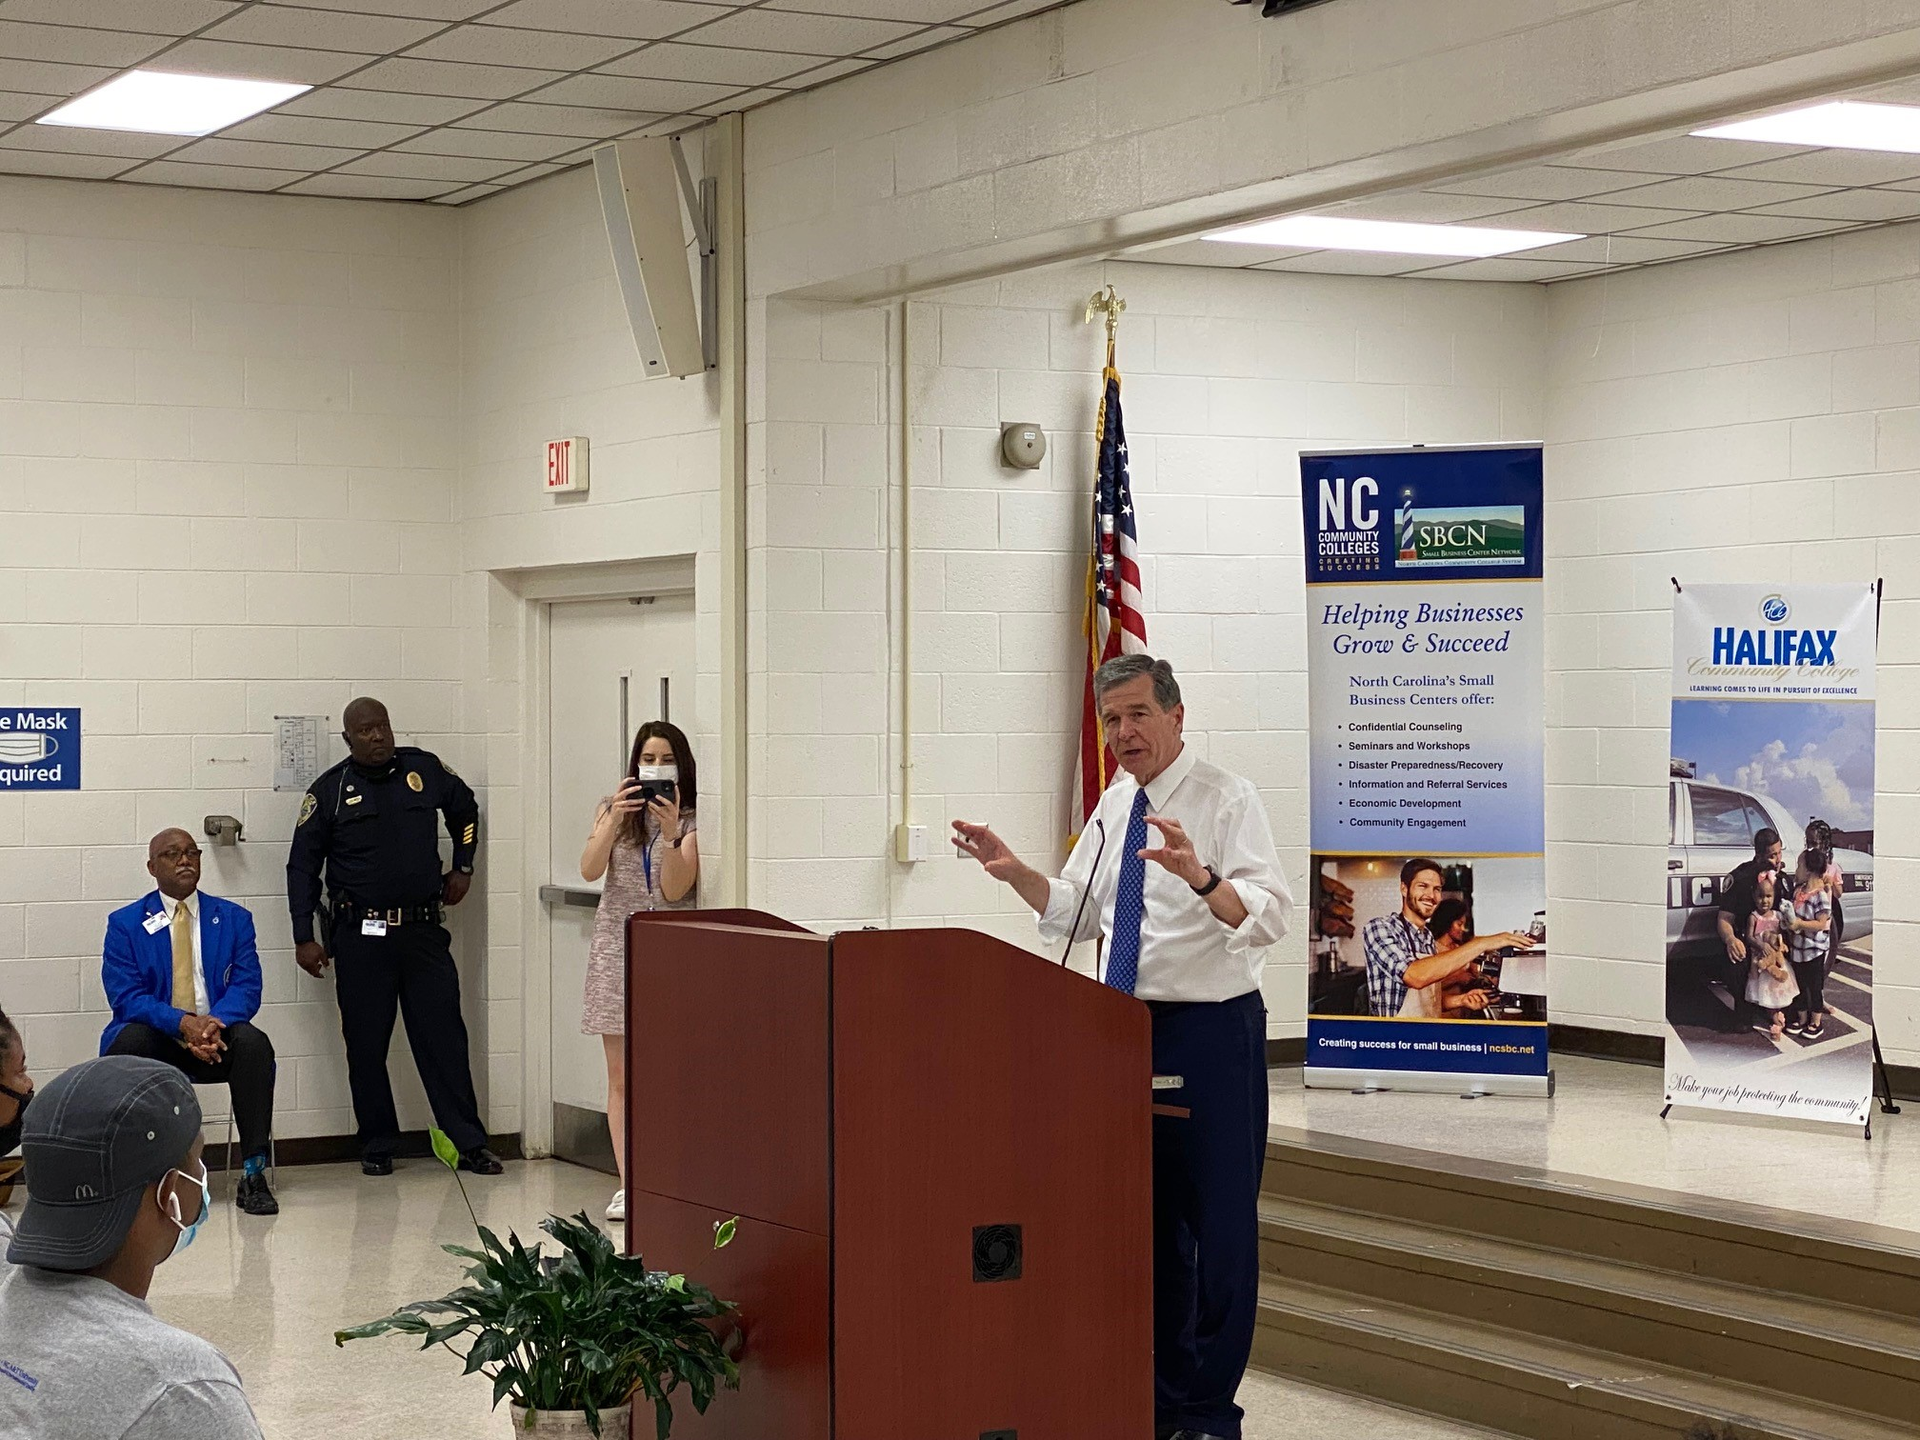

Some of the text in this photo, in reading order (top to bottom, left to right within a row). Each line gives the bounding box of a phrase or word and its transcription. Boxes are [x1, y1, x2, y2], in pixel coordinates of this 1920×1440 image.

[549, 441, 570, 486] EXIT
[1319, 476, 1379, 531] NC
[1318, 531, 1379, 543] COMMUNITY
[1420, 525, 1486, 547] SBCN
[1318, 542, 1380, 555] COLLEGES
[1422, 550, 1440, 558] SMALL
[1467, 548, 1490, 556] CENTER
[1491, 548, 1522, 556] NETWORK
[1318, 557, 1380, 565] CREATING
[1320, 564, 1380, 572] SUCCESS
[1321, 602, 1524, 630] Helping Businesses
[1333, 630, 1511, 654] Grow & Succeed
[1712, 627, 1838, 666] HALIFAX
[1687, 657, 1860, 682] Community College
[1349, 674, 1494, 687] North Carolina's Small
[1349, 693, 1494, 706] Business Centers offer:
[16, 712, 68, 730] Mask
[1348, 722, 1462, 733] Confidential Counseling
[1348, 741, 1470, 752] Seminars and Workshops
[1348, 761, 1504, 772] Disaster Preparedness/Recovery
[1348, 780, 1508, 789] Information and Referral Services
[1349, 799, 1461, 810] Economic Development
[1349, 818, 1466, 829] Community Engagement
[1318, 1037, 1357, 1049] Creating
[1359, 1040, 1396, 1049] success
[1398, 1040, 1412, 1050] for
[1413, 1041, 1438, 1051] small
[1440, 1042, 1482, 1052] business
[1489, 1043, 1535, 1054] ncsbc.net
[1668, 1073, 1867, 1117] Make your job protecting the community!
